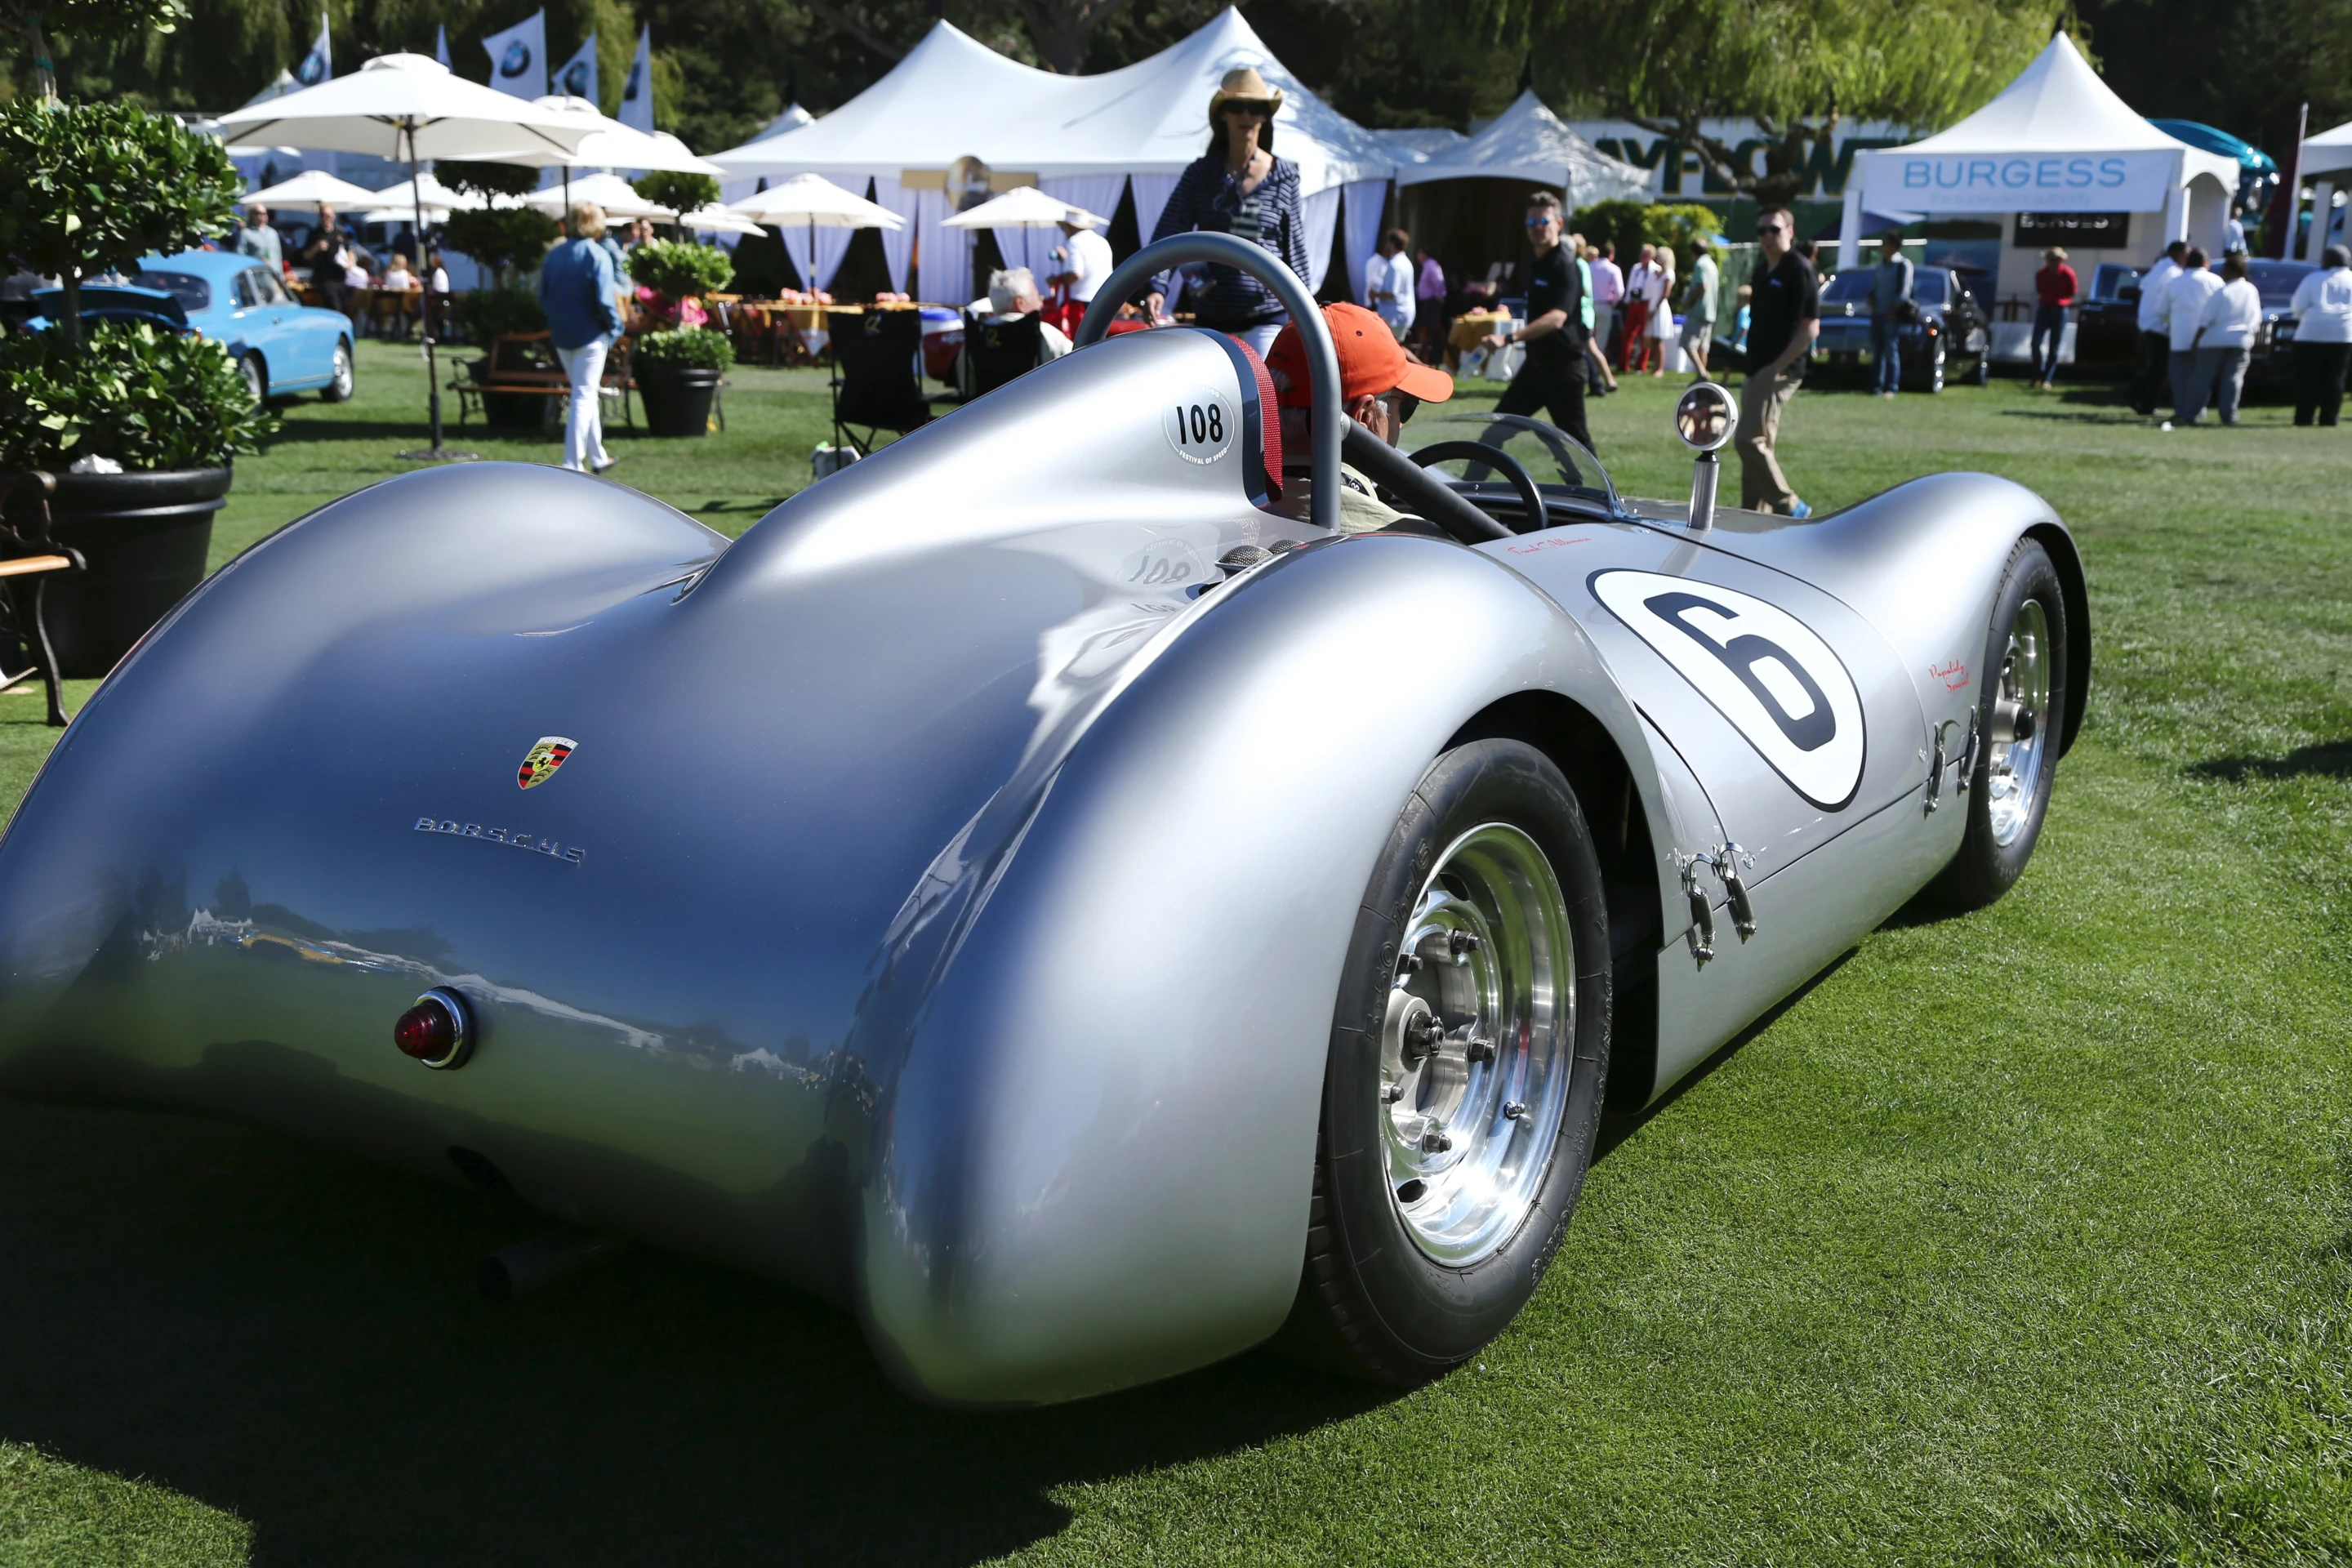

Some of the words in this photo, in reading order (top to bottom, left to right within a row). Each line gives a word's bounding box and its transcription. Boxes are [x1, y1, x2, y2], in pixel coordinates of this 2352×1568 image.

[1904, 158, 2127, 189] BURGESS
[1176, 403, 1223, 445] 108
[1178, 449, 1205, 465] FESTIVAL
[1205, 457, 1213, 465] OF
[1213, 447, 1227, 462] SPEED
[1643, 591, 1837, 752] 6
[540, 737, 577, 749] PORSCHE
[414, 817, 586, 864] PORSCHE
